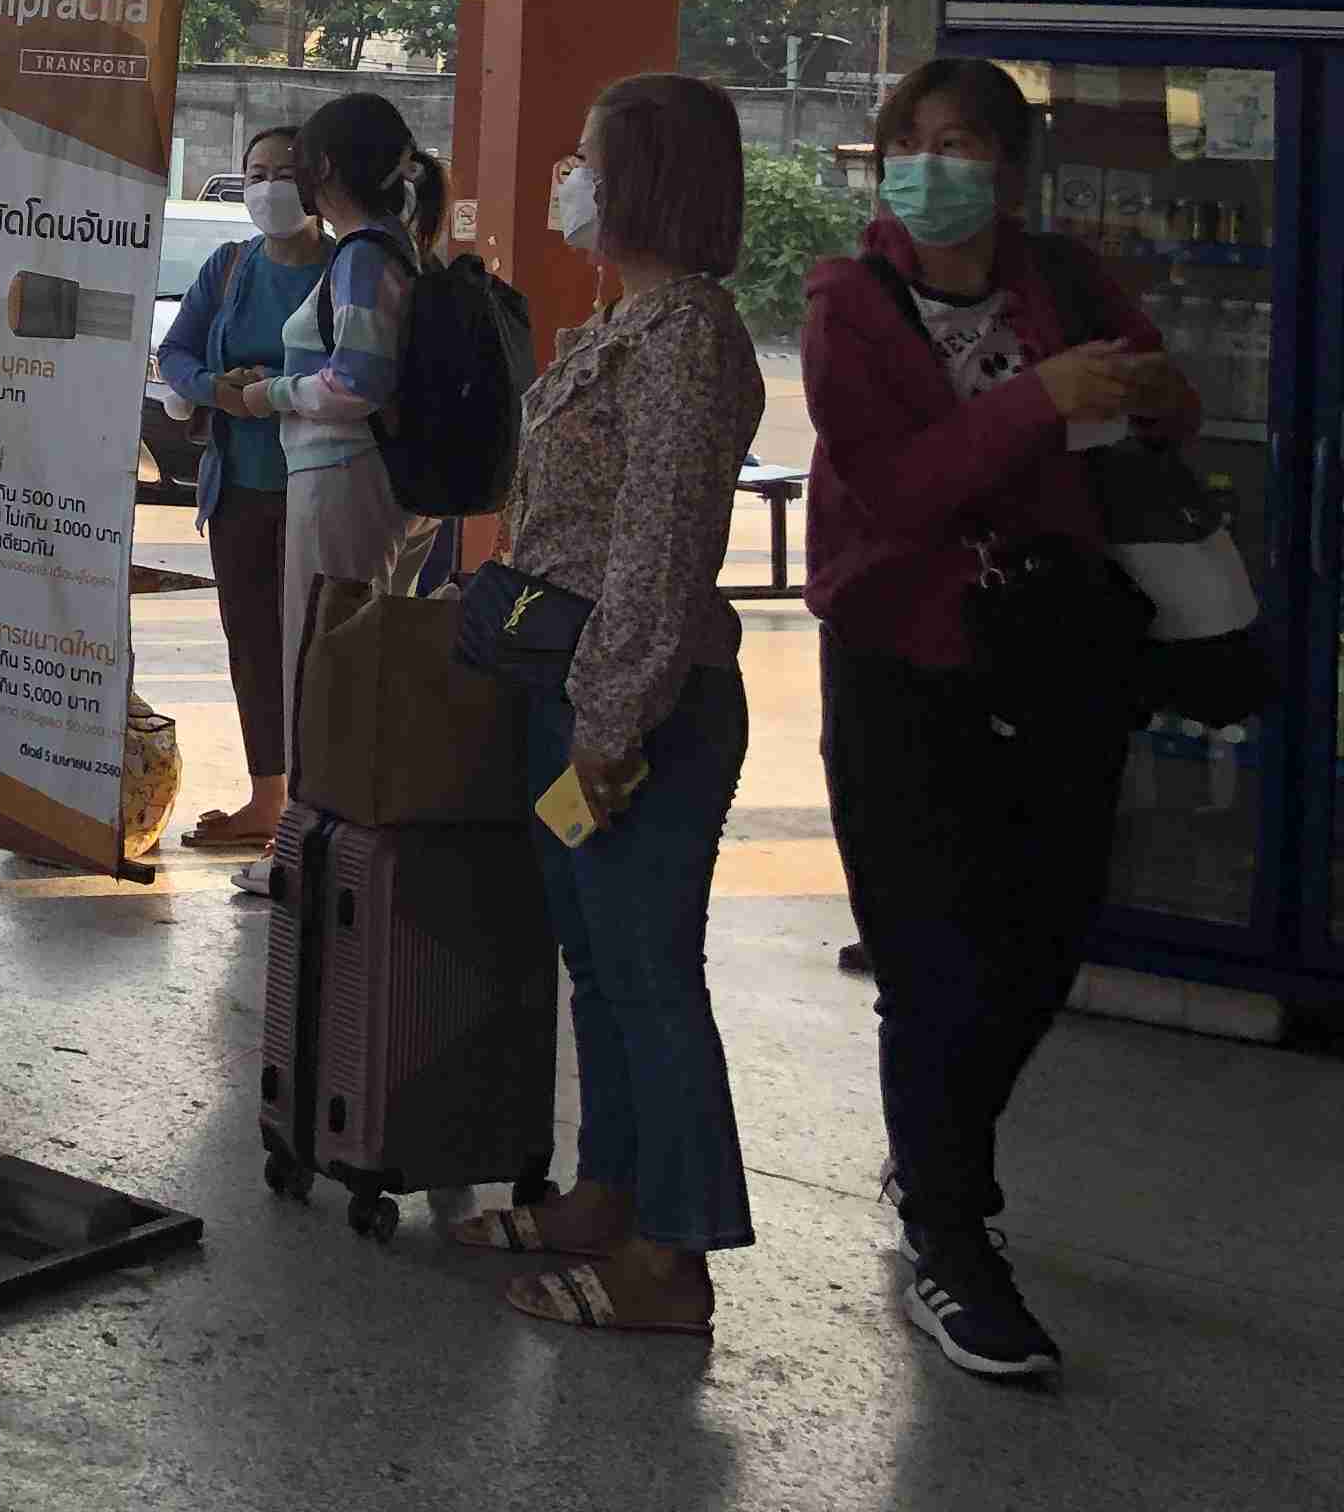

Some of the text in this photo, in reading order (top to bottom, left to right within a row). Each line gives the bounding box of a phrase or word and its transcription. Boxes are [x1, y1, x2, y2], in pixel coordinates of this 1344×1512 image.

[34, 54, 138, 75] TRANSPORT
[21, 488, 54, 508] 500
[58, 495, 86, 514] บาท
[53, 518, 92, 539] 1000
[95, 527, 121, 545] บาท
[23, 655, 65, 679] 5,000
[70, 667, 103, 686] บาท
[23, 682, 63, 707] 5,000
[67, 695, 100, 714] บาท
